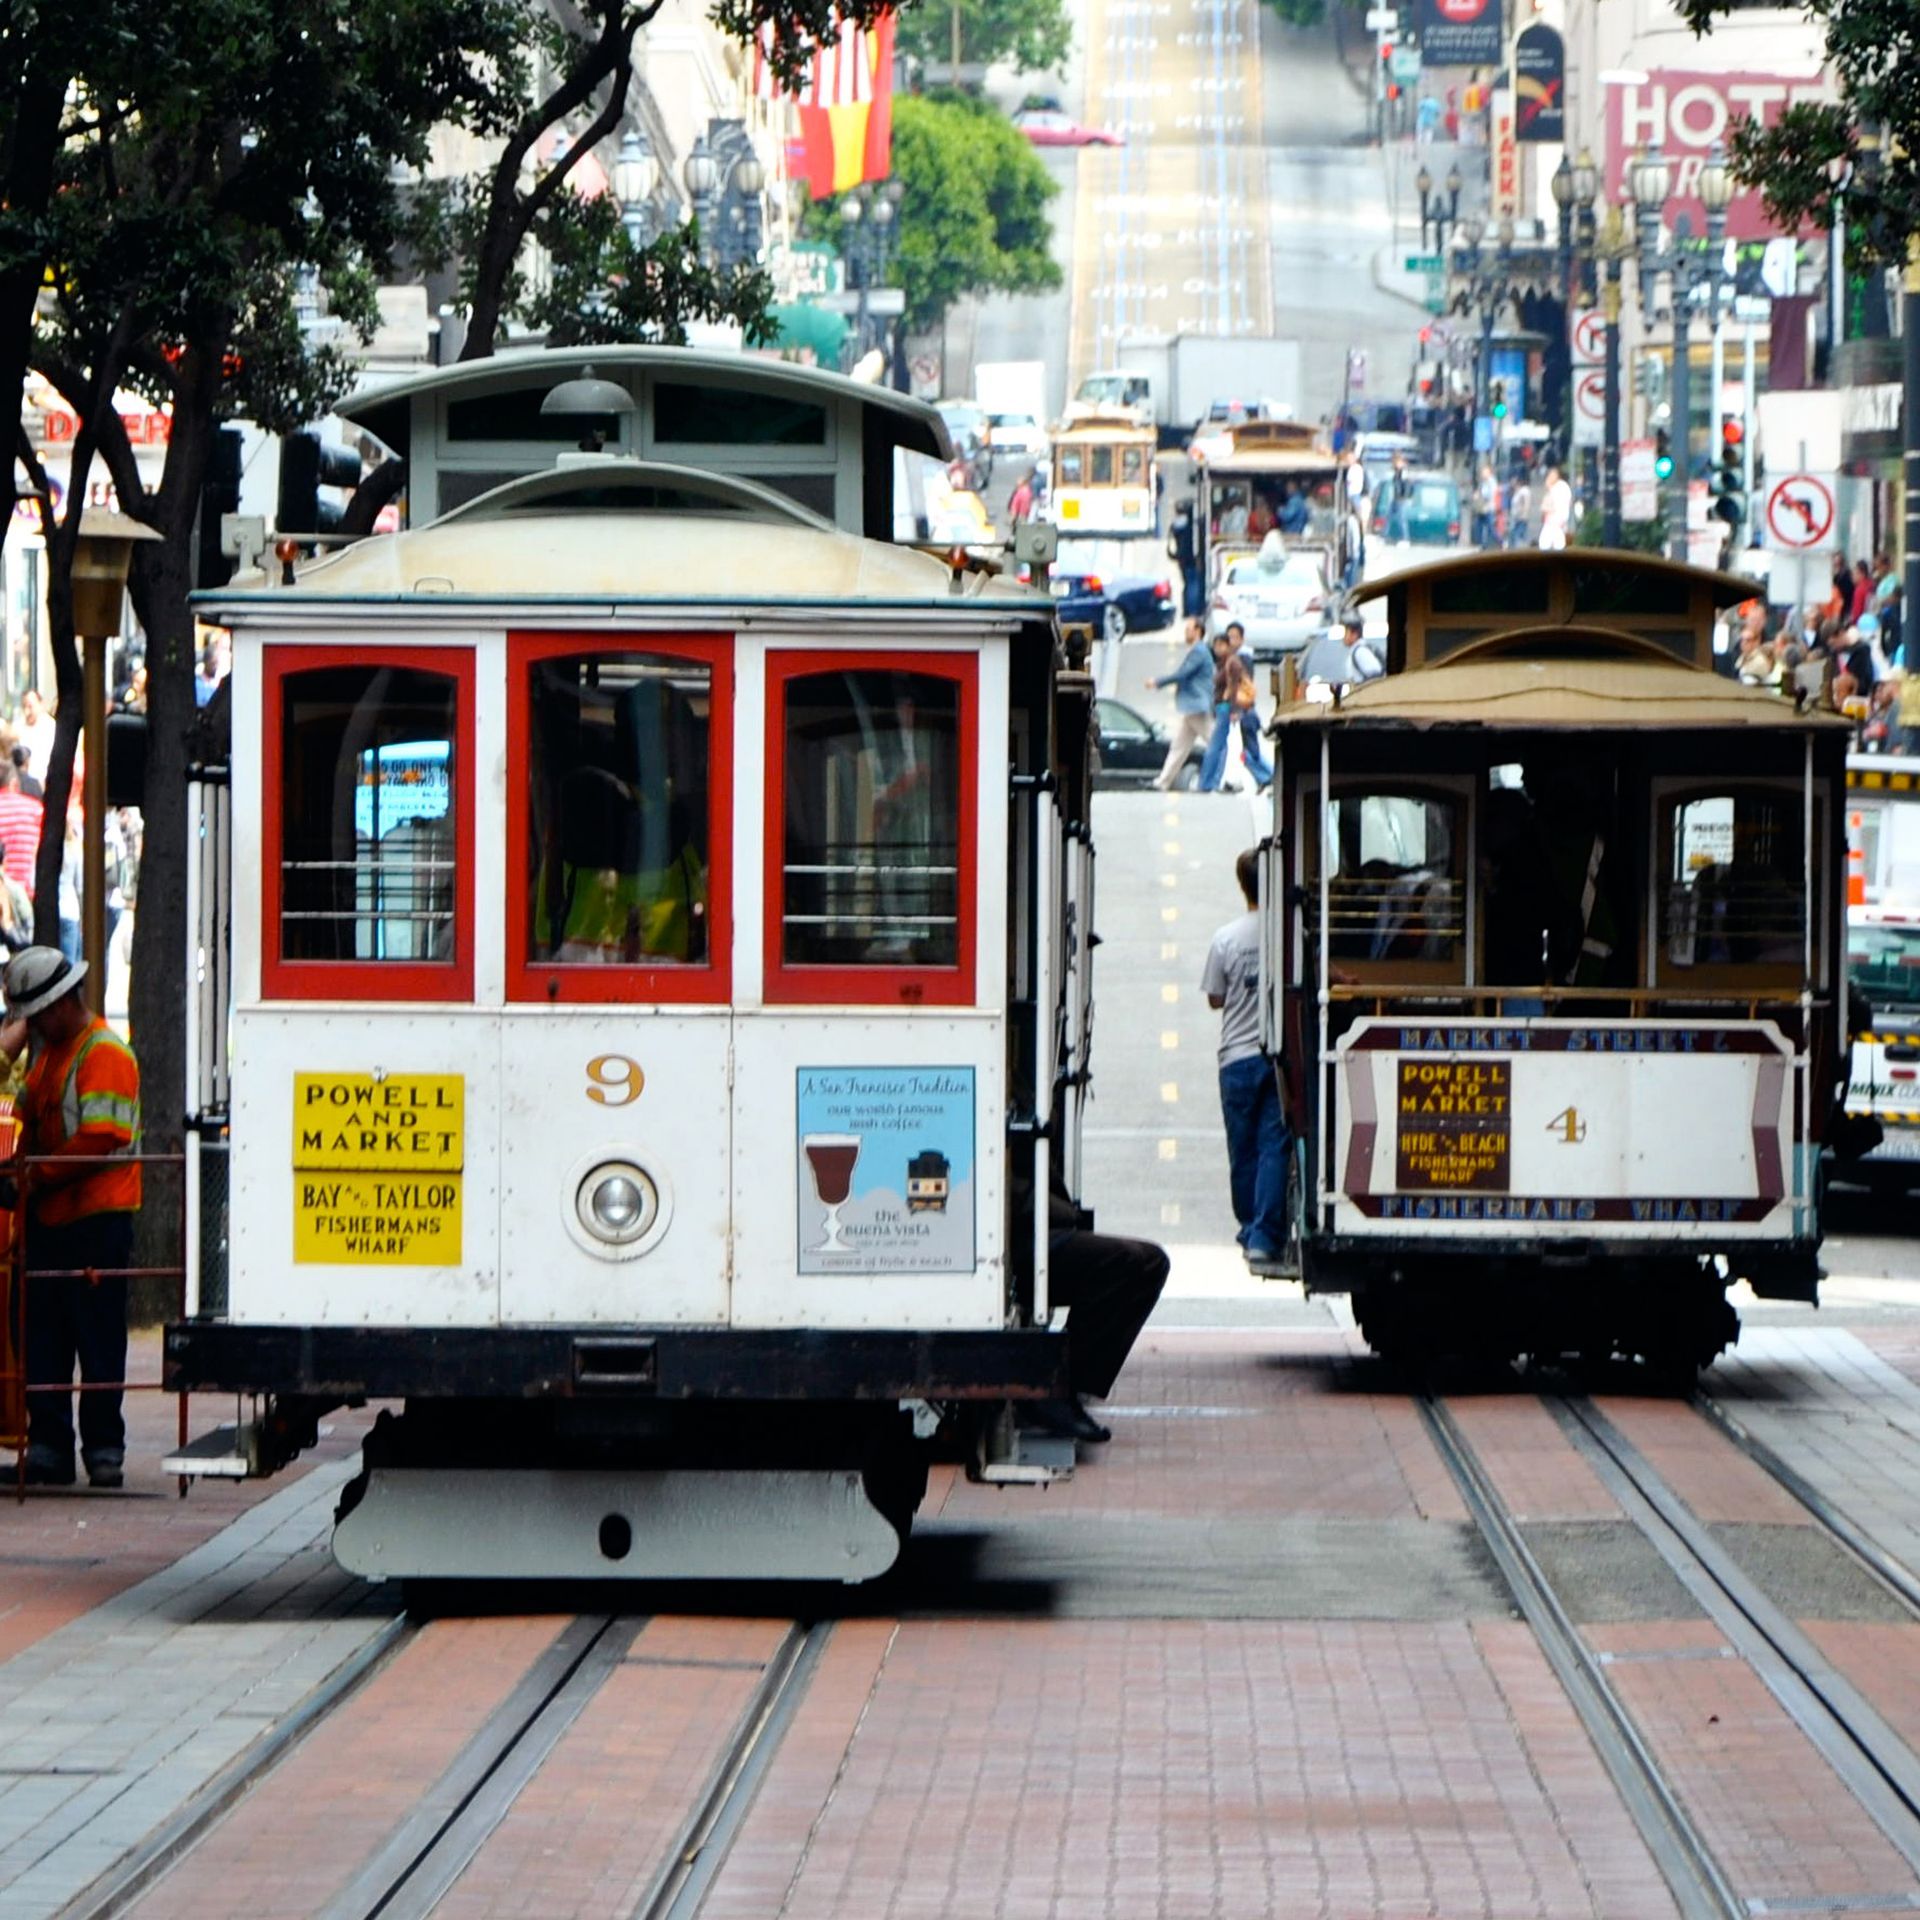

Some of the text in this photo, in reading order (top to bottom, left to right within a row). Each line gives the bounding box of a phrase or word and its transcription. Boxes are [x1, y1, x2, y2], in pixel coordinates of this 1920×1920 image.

[1400, 1029, 1534, 1050] MARKET
[1566, 1030, 1699, 1051] STREET
[585, 1053, 645, 1107] 9
[803, 1077, 816, 1096] A
[819, 1077, 843, 1095] San
[908, 1074, 969, 1096] Tradition
[1403, 1066, 1505, 1084] POWELL
[306, 1085, 455, 1108] POWELL
[1431, 1083, 1480, 1095] AND
[1402, 1096, 1506, 1113] MARKET
[346, 1111, 417, 1128] AND
[1546, 1105, 1587, 1144] 4
[302, 1130, 456, 1153] MARKET
[1401, 1133, 1438, 1153] HYDE
[1459, 1133, 1505, 1153] BEACH
[1409, 1155, 1496, 1170] FISHERMANS
[1430, 1169, 1475, 1183] WHARF
[303, 1184, 341, 1210] BAY
[373, 1184, 456, 1210] TAYLOR
[1382, 1199, 1742, 1221] FISHERMANS WHARF
[316, 1215, 441, 1235] FISHERMANS
[346, 1237, 409, 1254] WHARF
